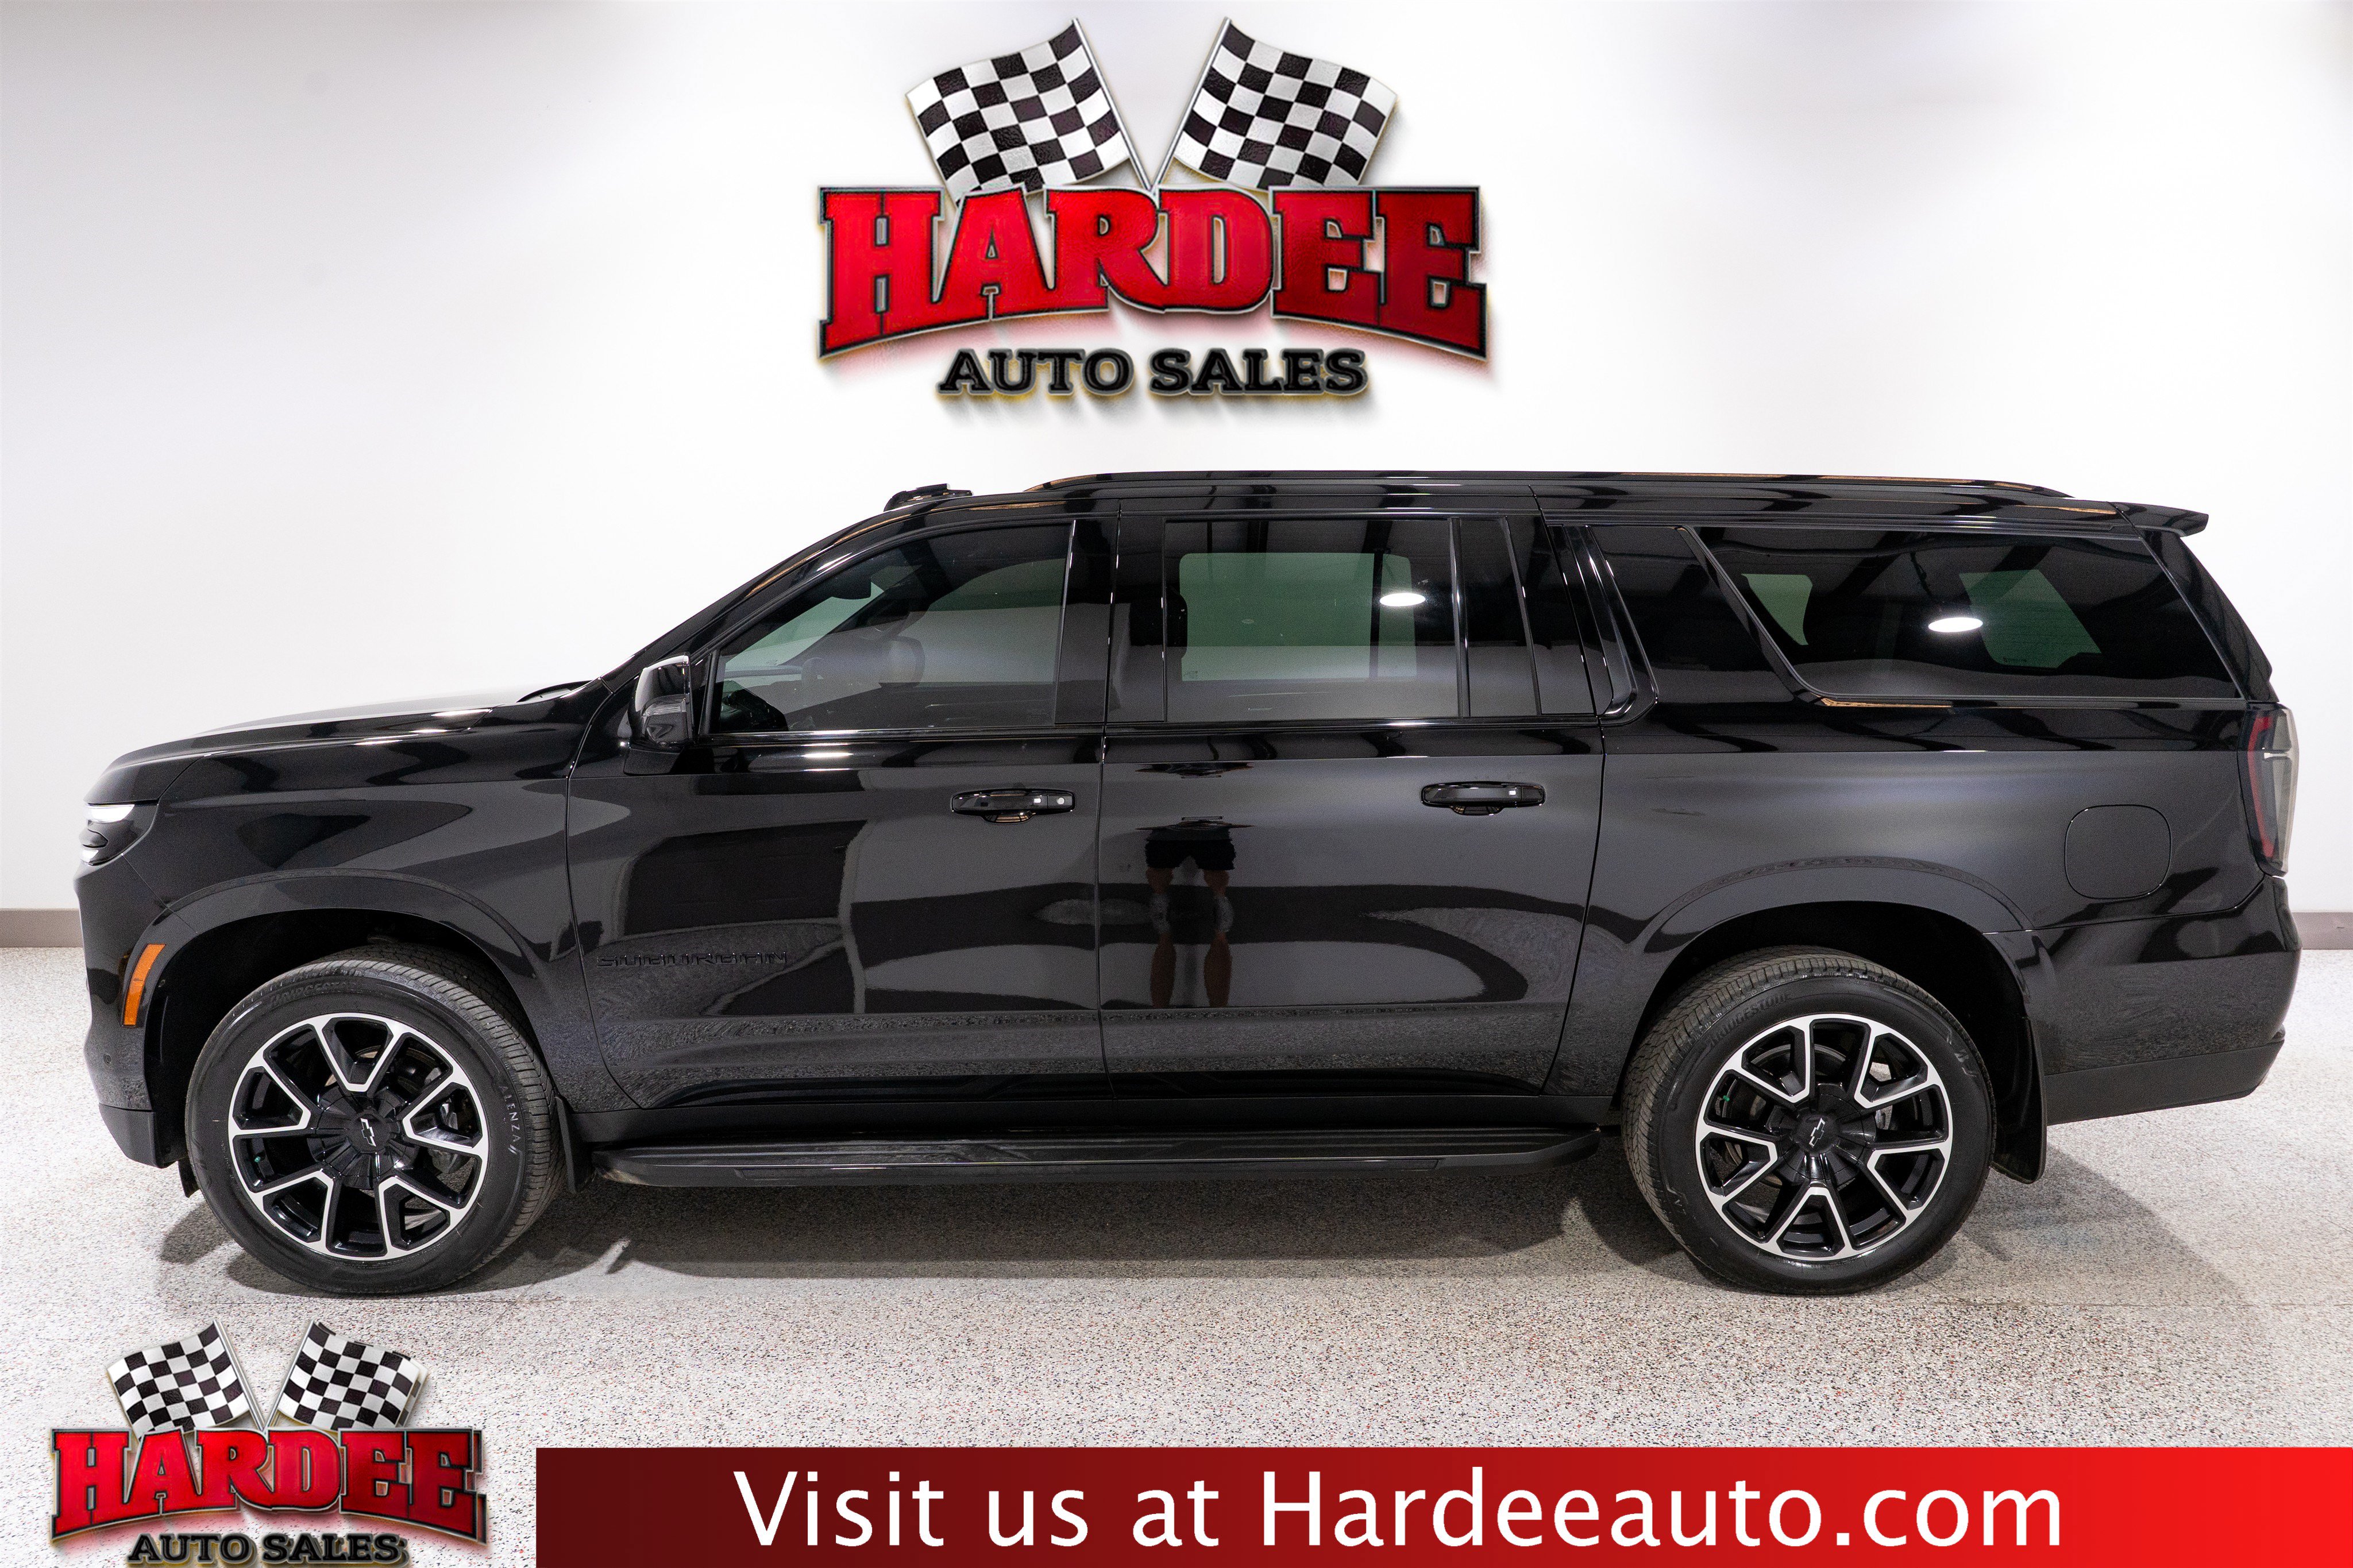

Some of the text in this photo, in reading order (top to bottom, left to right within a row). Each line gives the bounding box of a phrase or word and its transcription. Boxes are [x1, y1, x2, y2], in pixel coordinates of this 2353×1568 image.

[817, 186, 1487, 358] HARDEE
[938, 348, 1368, 395] AUTO SALES
[597, 952, 787, 967] SUBURBAN
